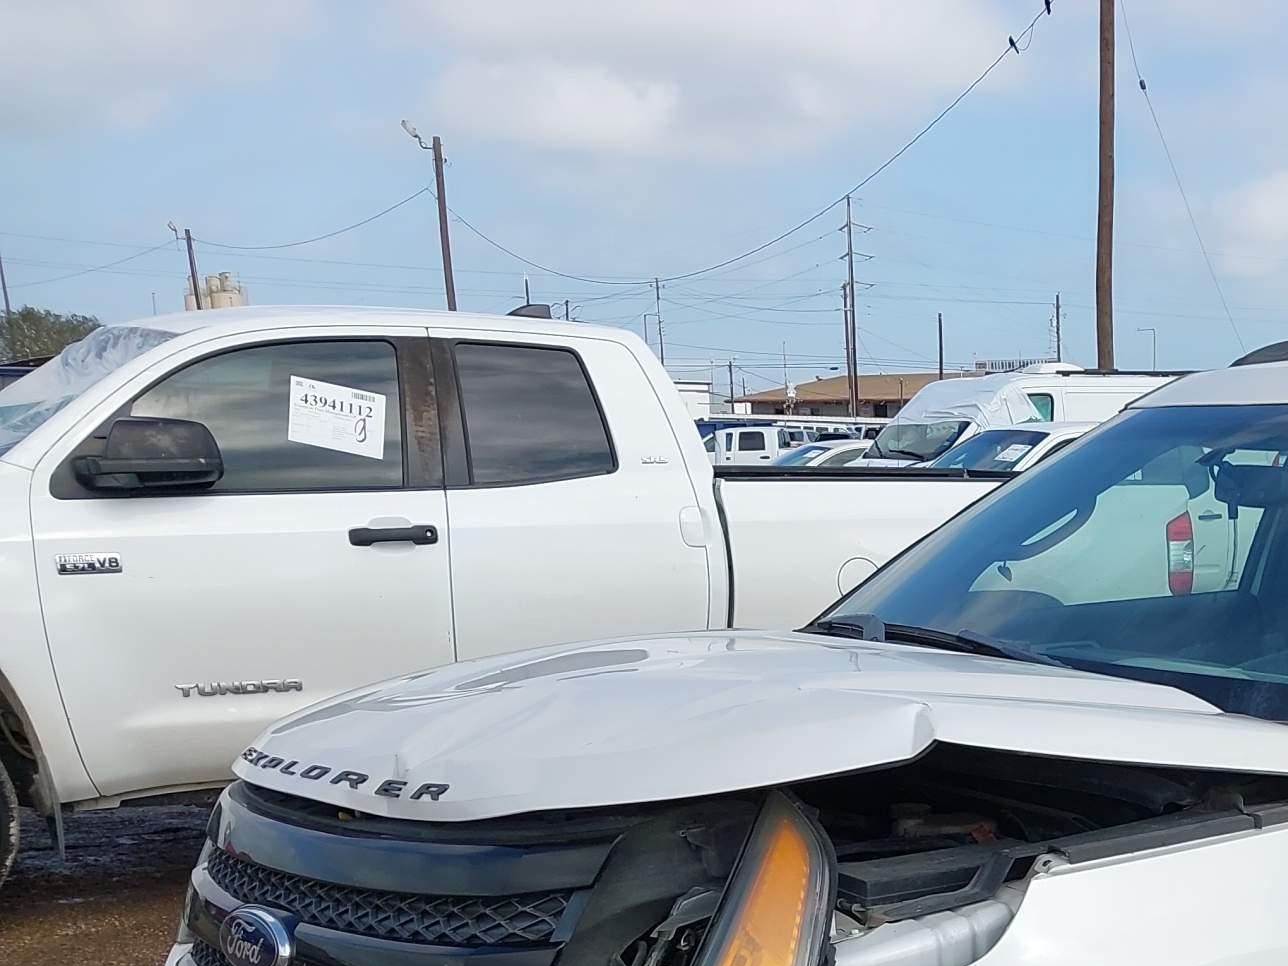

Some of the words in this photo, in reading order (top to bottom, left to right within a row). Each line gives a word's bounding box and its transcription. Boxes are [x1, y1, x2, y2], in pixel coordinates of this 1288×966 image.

[300, 393, 373, 418] 43941112
[96, 556, 120, 568] V8
[175, 678, 303, 698] TUNDRA
[241, 747, 450, 801] EXPLORER
[227, 919, 264, 964] Ford
